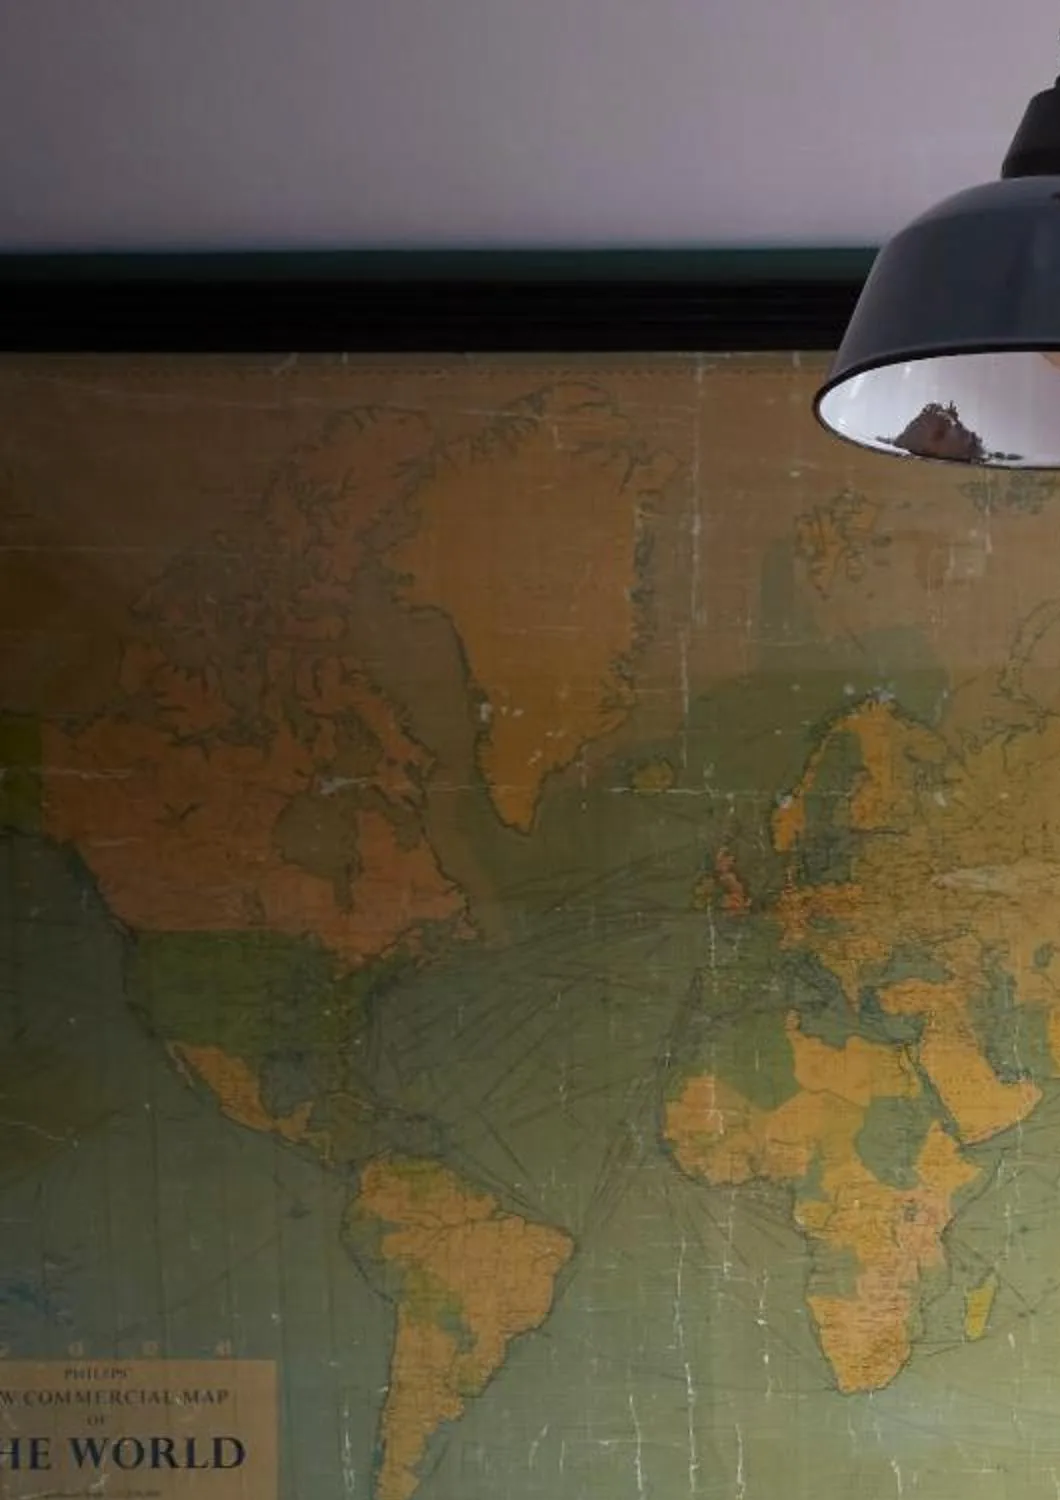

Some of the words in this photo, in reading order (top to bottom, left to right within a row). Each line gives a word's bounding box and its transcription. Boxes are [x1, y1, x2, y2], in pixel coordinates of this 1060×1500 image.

[23, 1389, 176, 1406] COMMERCIAL
[182, 1389, 230, 1405] MAP
[67, 1436, 246, 1470] WORLD
